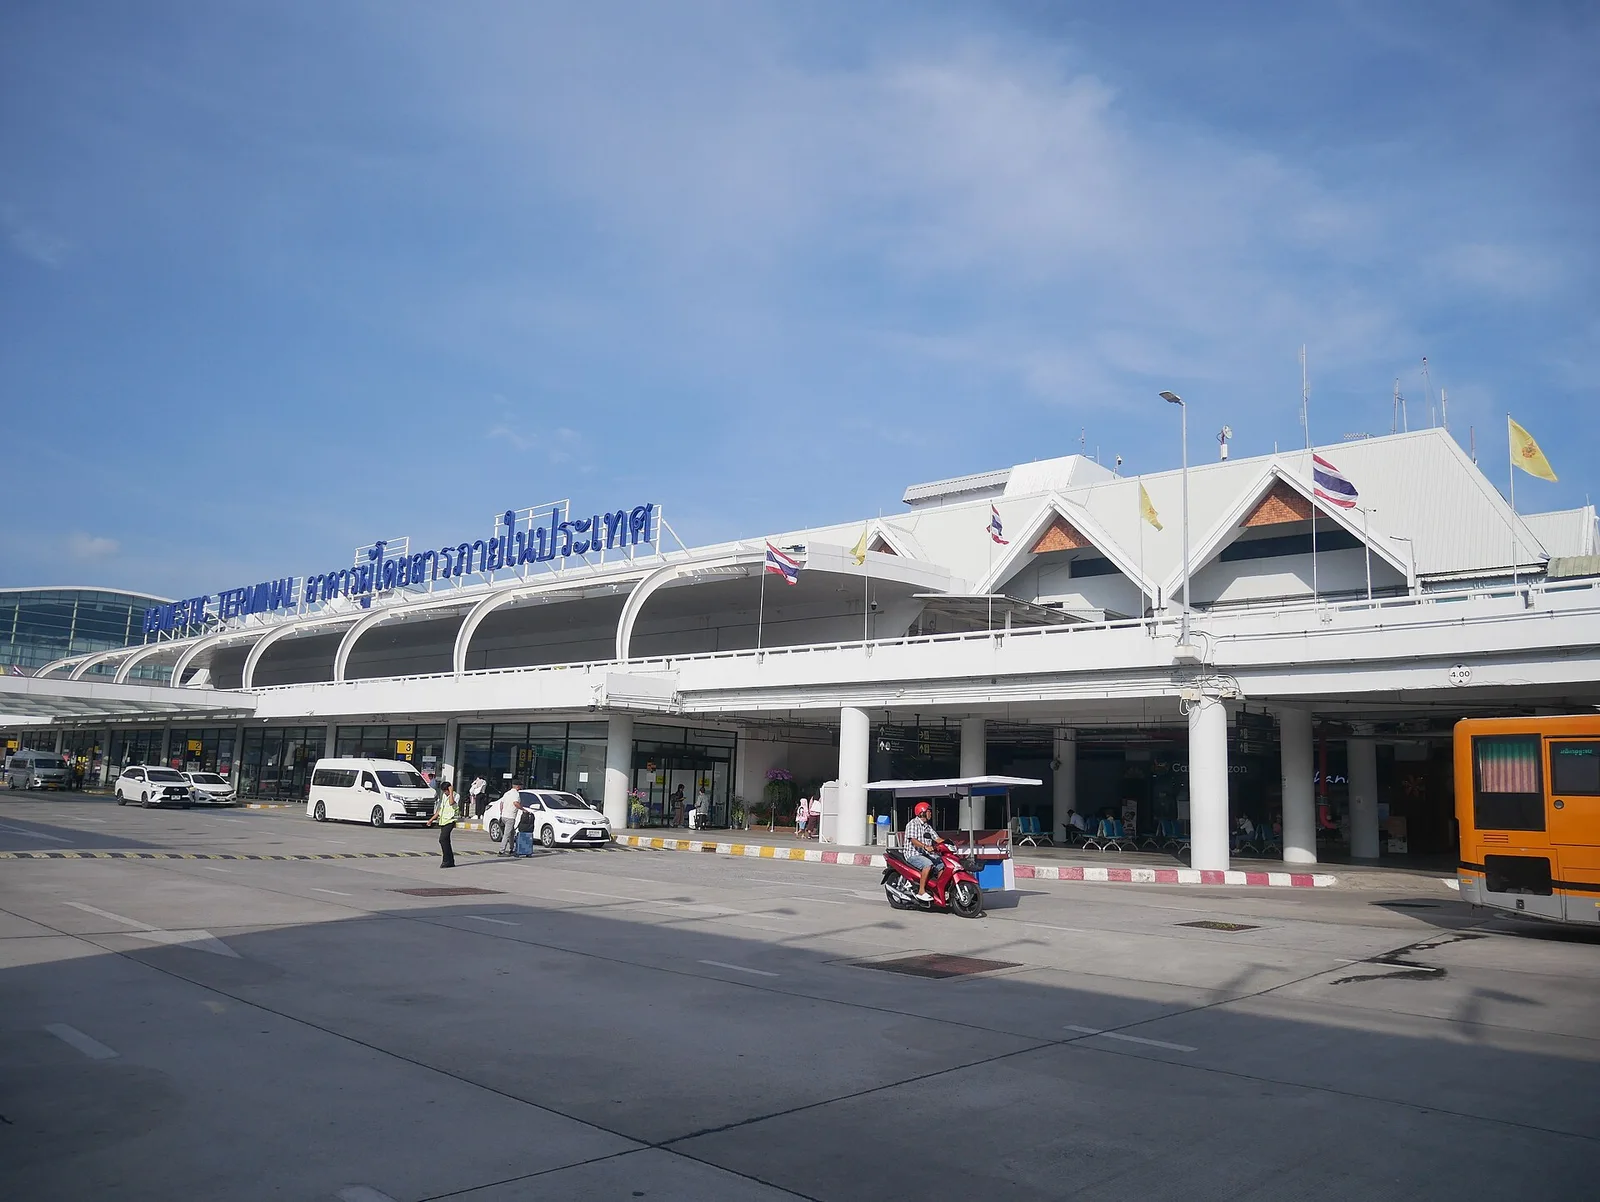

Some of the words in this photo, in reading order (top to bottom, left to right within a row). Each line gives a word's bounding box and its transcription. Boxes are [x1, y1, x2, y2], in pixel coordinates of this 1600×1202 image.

[217, 576, 297, 620] TERMINAL
[1449, 670, 1470, 678] 4.00
[195, 742, 201, 750] 2
[405, 743, 412, 752] 3
